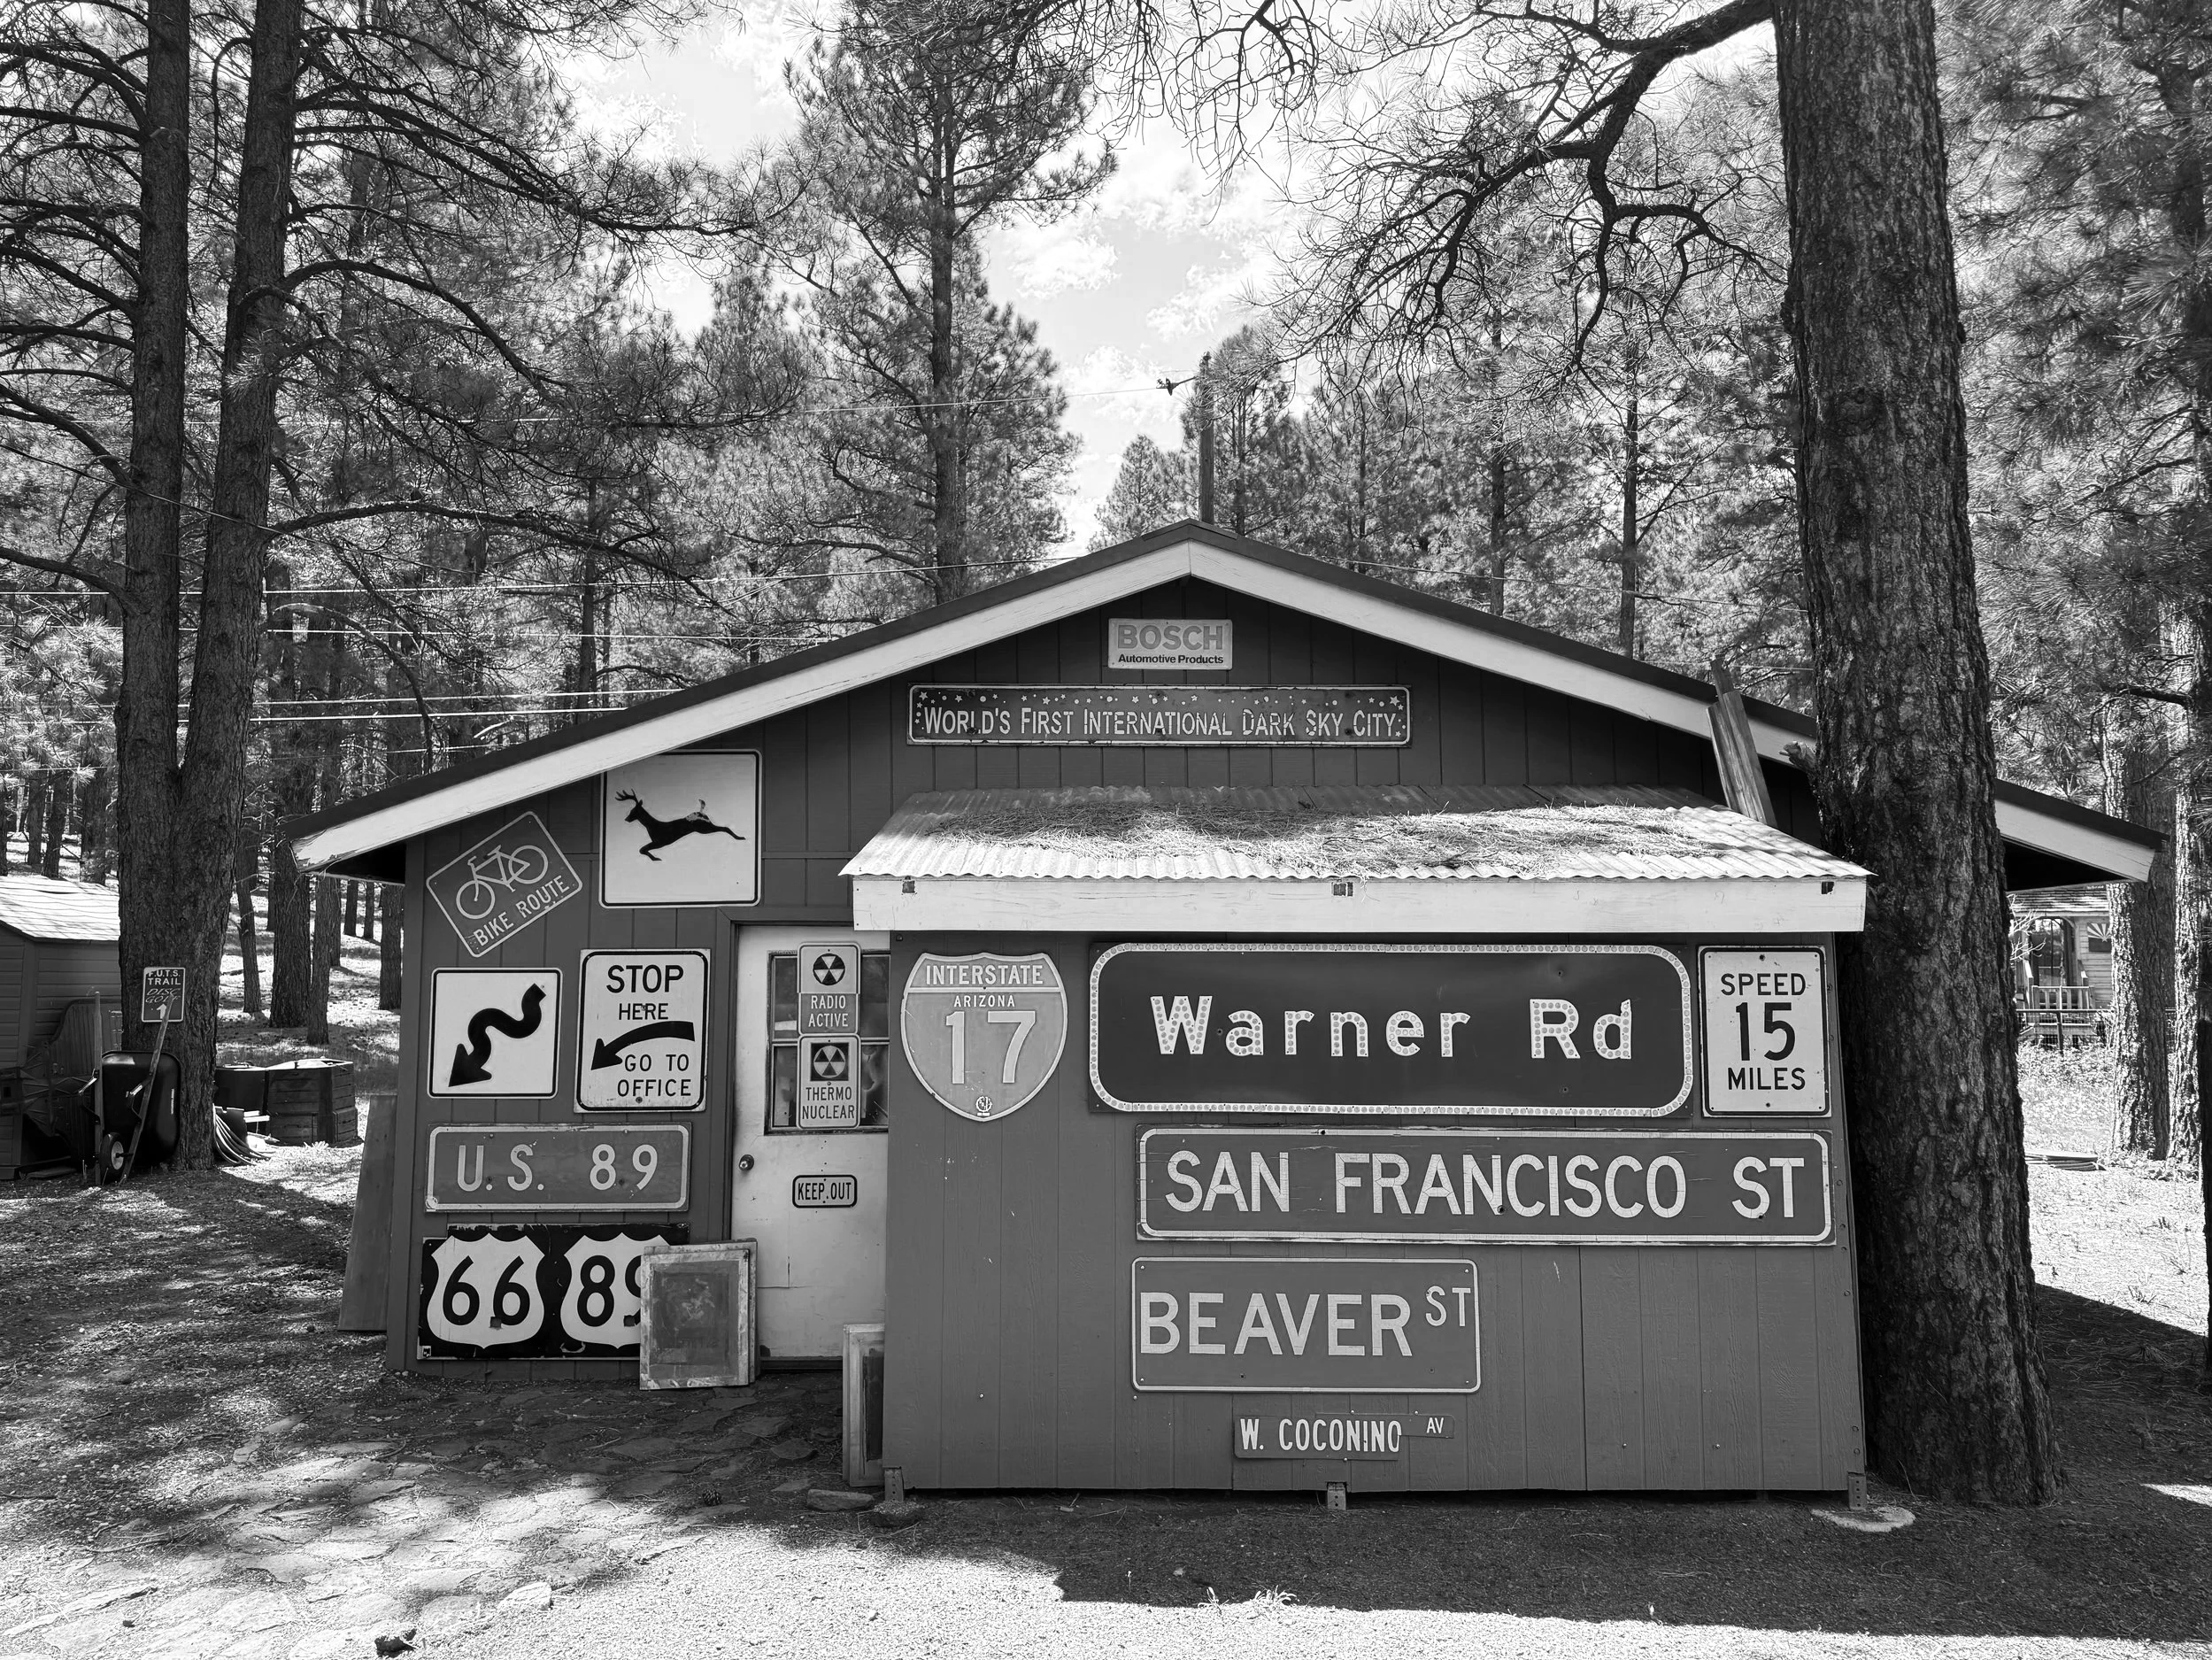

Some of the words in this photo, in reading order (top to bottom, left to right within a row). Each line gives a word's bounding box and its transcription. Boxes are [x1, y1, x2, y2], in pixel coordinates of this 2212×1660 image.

[1117, 624, 1223, 650] BOSCH
[1118, 653, 1175, 664] Automotive
[1178, 653, 1223, 665] Products
[1021, 708, 1074, 736] FIRST
[1083, 709, 1232, 737] INTERNATIONAL
[1242, 709, 1295, 737] DARK
[1306, 710, 1344, 737] SKY
[1353, 710, 1396, 737] CITY
[473, 911, 514, 946] BIKE
[515, 875, 570, 918] ROUTE
[606, 964, 684, 993] STOP
[926, 965, 1043, 984] INTERSTATE
[1721, 972, 1807, 996] SPEED
[619, 1003, 669, 1020] HERE
[811, 995, 846, 1009] RADIO
[953, 995, 1015, 1008] ARIZONA
[808, 1013, 849, 1027] ACTIVE
[1151, 994, 1471, 1058] Warner
[1529, 999, 1633, 1060] Rd
[1736, 1002, 1796, 1062] 15
[945, 1010, 1036, 1085] 17
[624, 1054, 652, 1072] GO
[666, 1054, 690, 1071] TO
[617, 1079, 691, 1097] OFFICE
[1728, 1068, 1806, 1091] MILES
[805, 1087, 852, 1100] THERMO
[802, 1106, 855, 1119] NUCLEAR
[457, 1144, 544, 1192] U.S.
[590, 1144, 658, 1190] 89
[1165, 1151, 1290, 1213] SAN
[1335, 1154, 1686, 1218] FRANCISCO
[1731, 1156, 1805, 1219] ST
[443, 1255, 530, 1326] 66
[1140, 1292, 1413, 1356] BEAVER
[1425, 1286, 1471, 1327] ST
[1240, 1418, 1264, 1450] W.
[1278, 1418, 1401, 1453] COCONINO
[1426, 1417, 1445, 1434] AV
